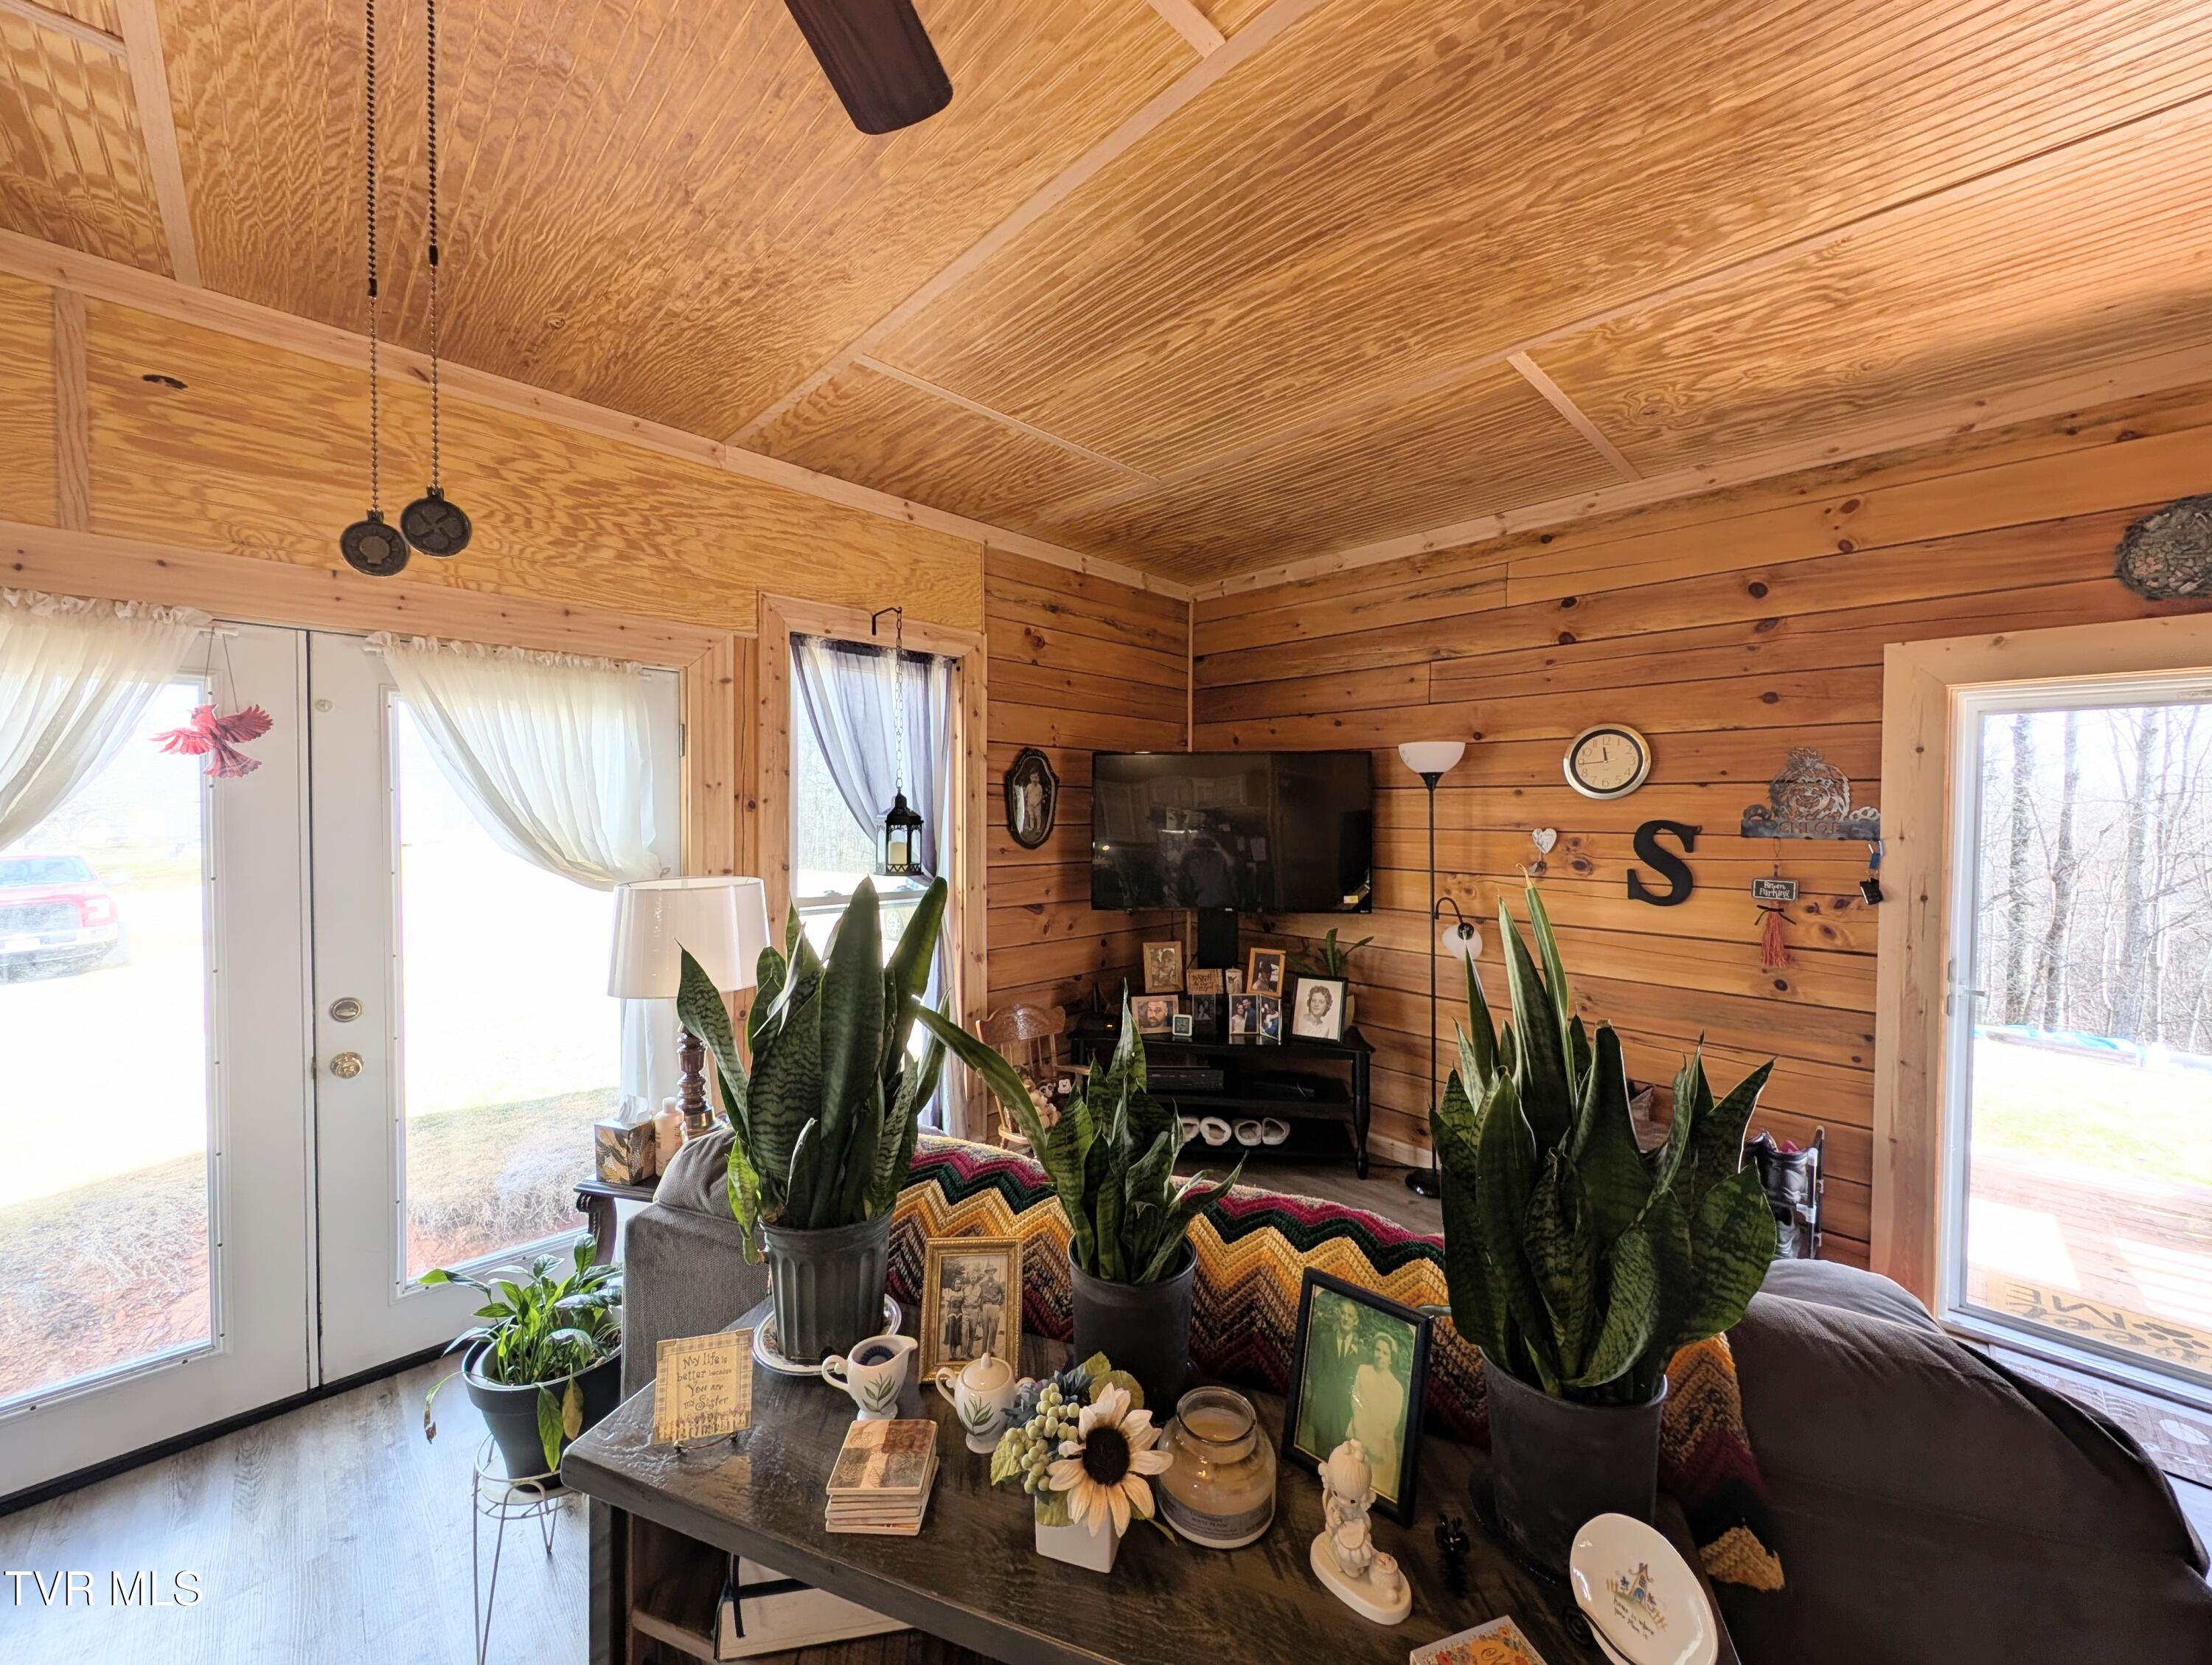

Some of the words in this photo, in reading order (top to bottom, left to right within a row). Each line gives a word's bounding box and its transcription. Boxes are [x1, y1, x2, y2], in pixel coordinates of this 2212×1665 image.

[1602, 737, 1611, 745] 12
[1618, 737, 1621, 746] 1
[1582, 747, 1592, 757] 10
[1625, 745, 1632, 754] 2
[1630, 756, 1635, 765] 3
[1582, 769, 1588, 778] 8
[1624, 768, 1631, 776] 4
[1591, 776, 1597, 785] 7
[1601, 779, 1610, 787] 6
[1615, 776, 1621, 785] 5
[1627, 820, 1696, 906] S
[683, 1355, 700, 1369] My
[703, 1352, 720, 1366] life
[676, 1370, 706, 1382] better
[685, 1380, 707, 1397] You
